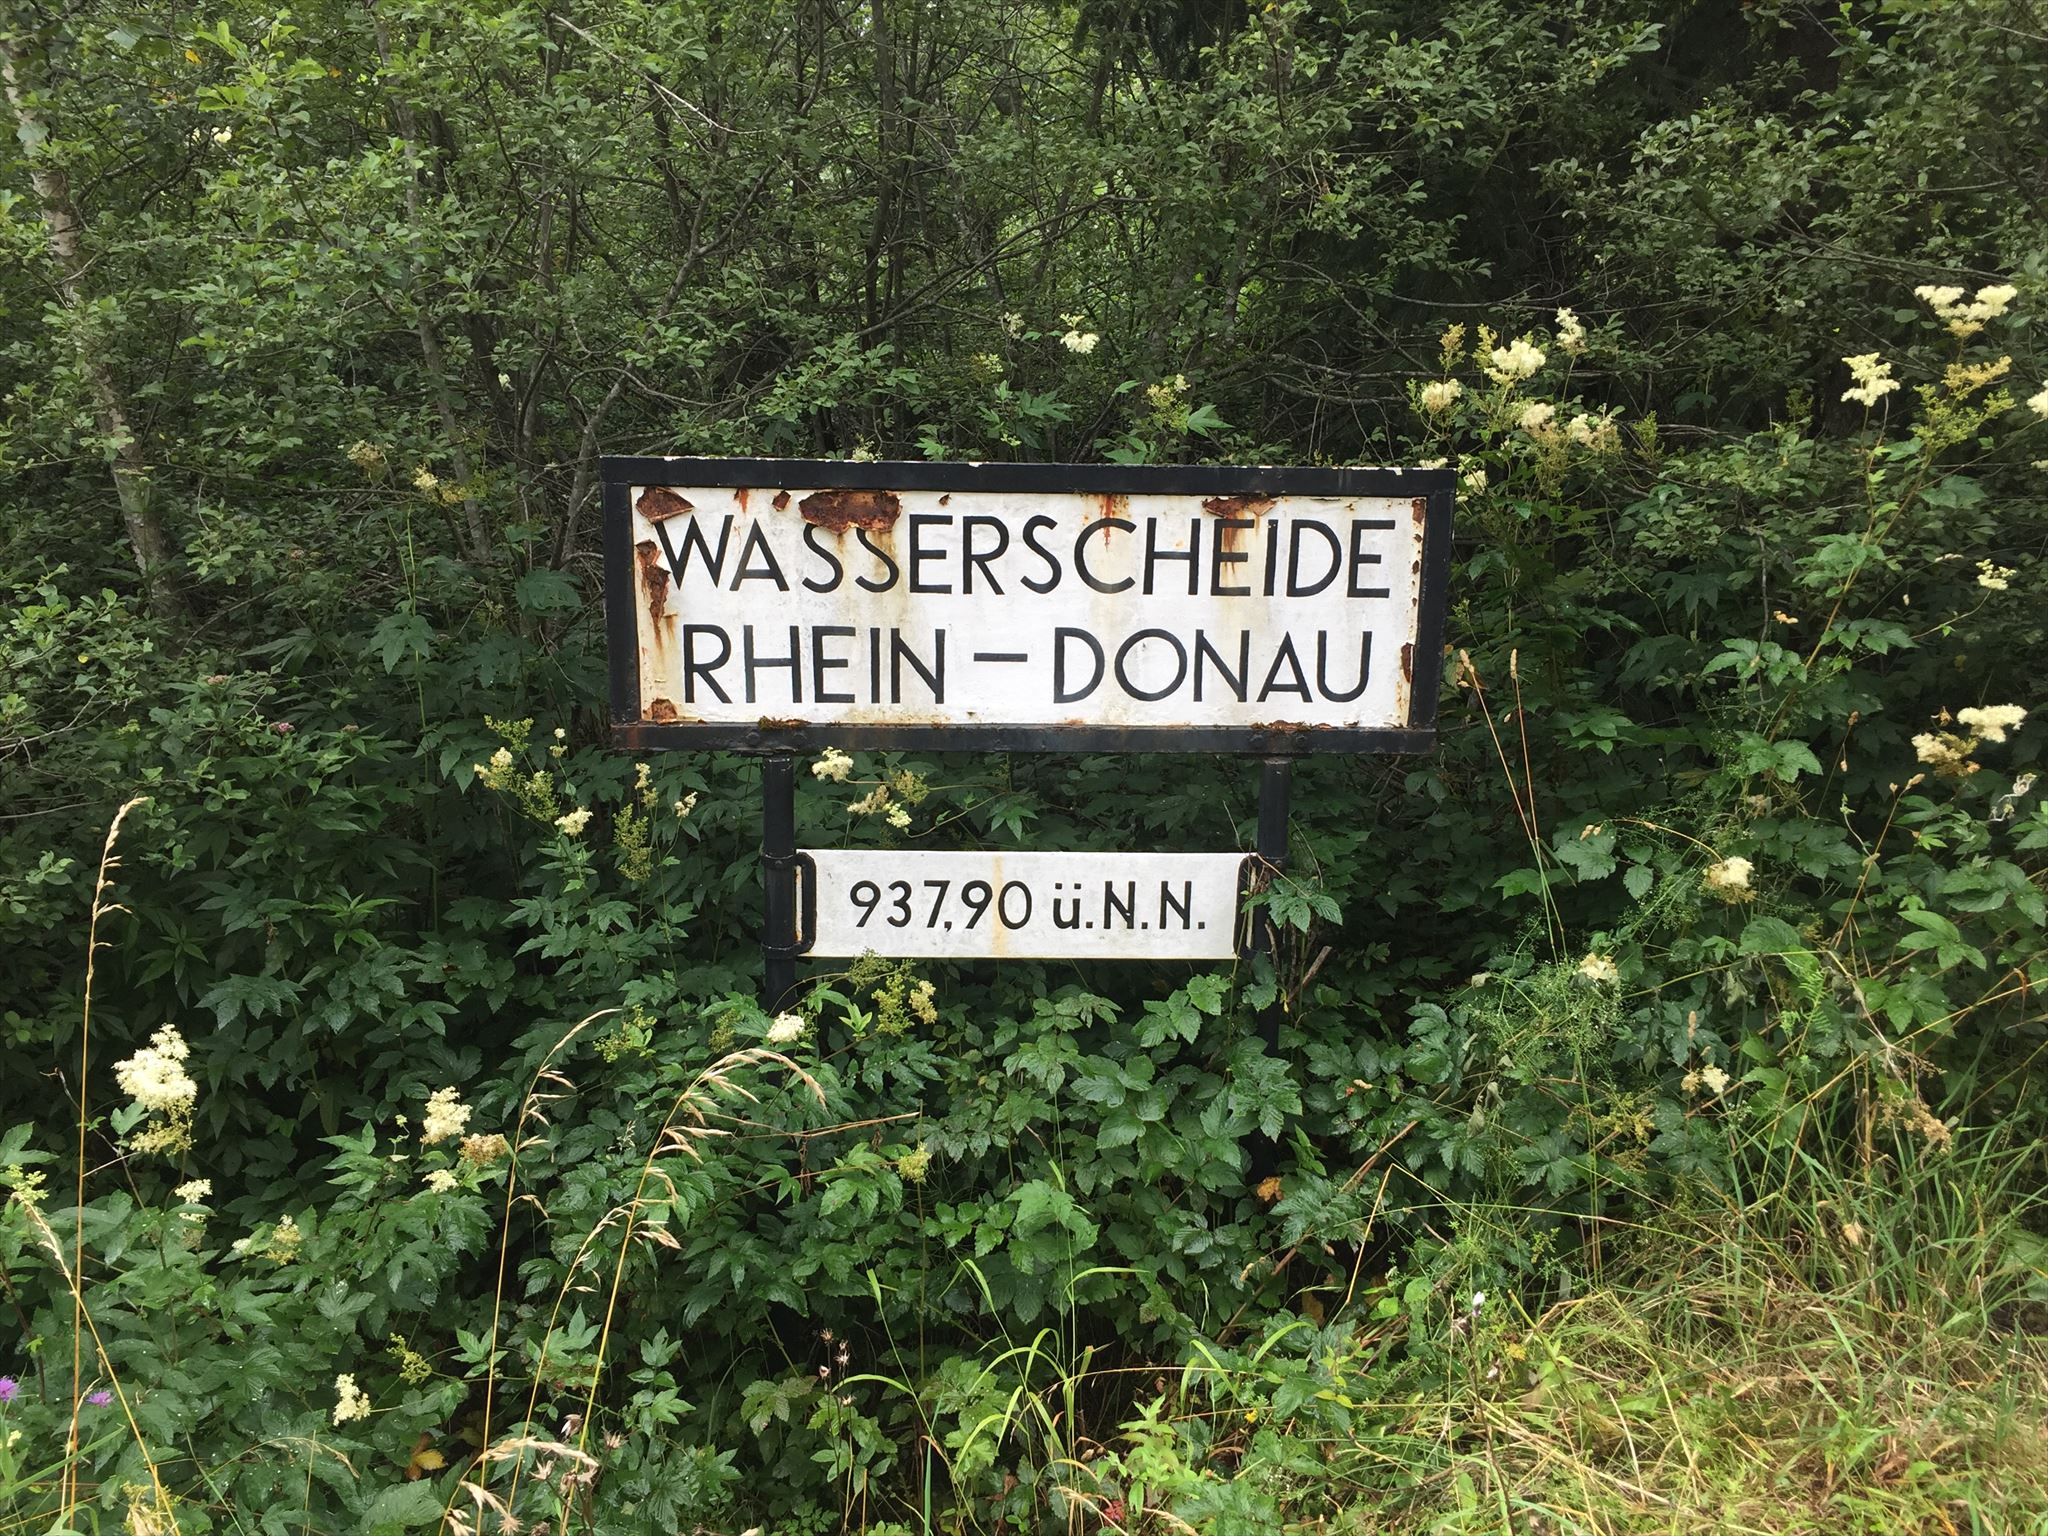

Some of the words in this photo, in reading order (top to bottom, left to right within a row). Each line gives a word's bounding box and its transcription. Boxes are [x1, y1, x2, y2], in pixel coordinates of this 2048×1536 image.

[653, 513, 1396, 599] WASSERSCHEIDE
[683, 623, 946, 704] RHEIN
[1053, 627, 1373, 703] DONAU
[849, 879, 1032, 933] 937,90
